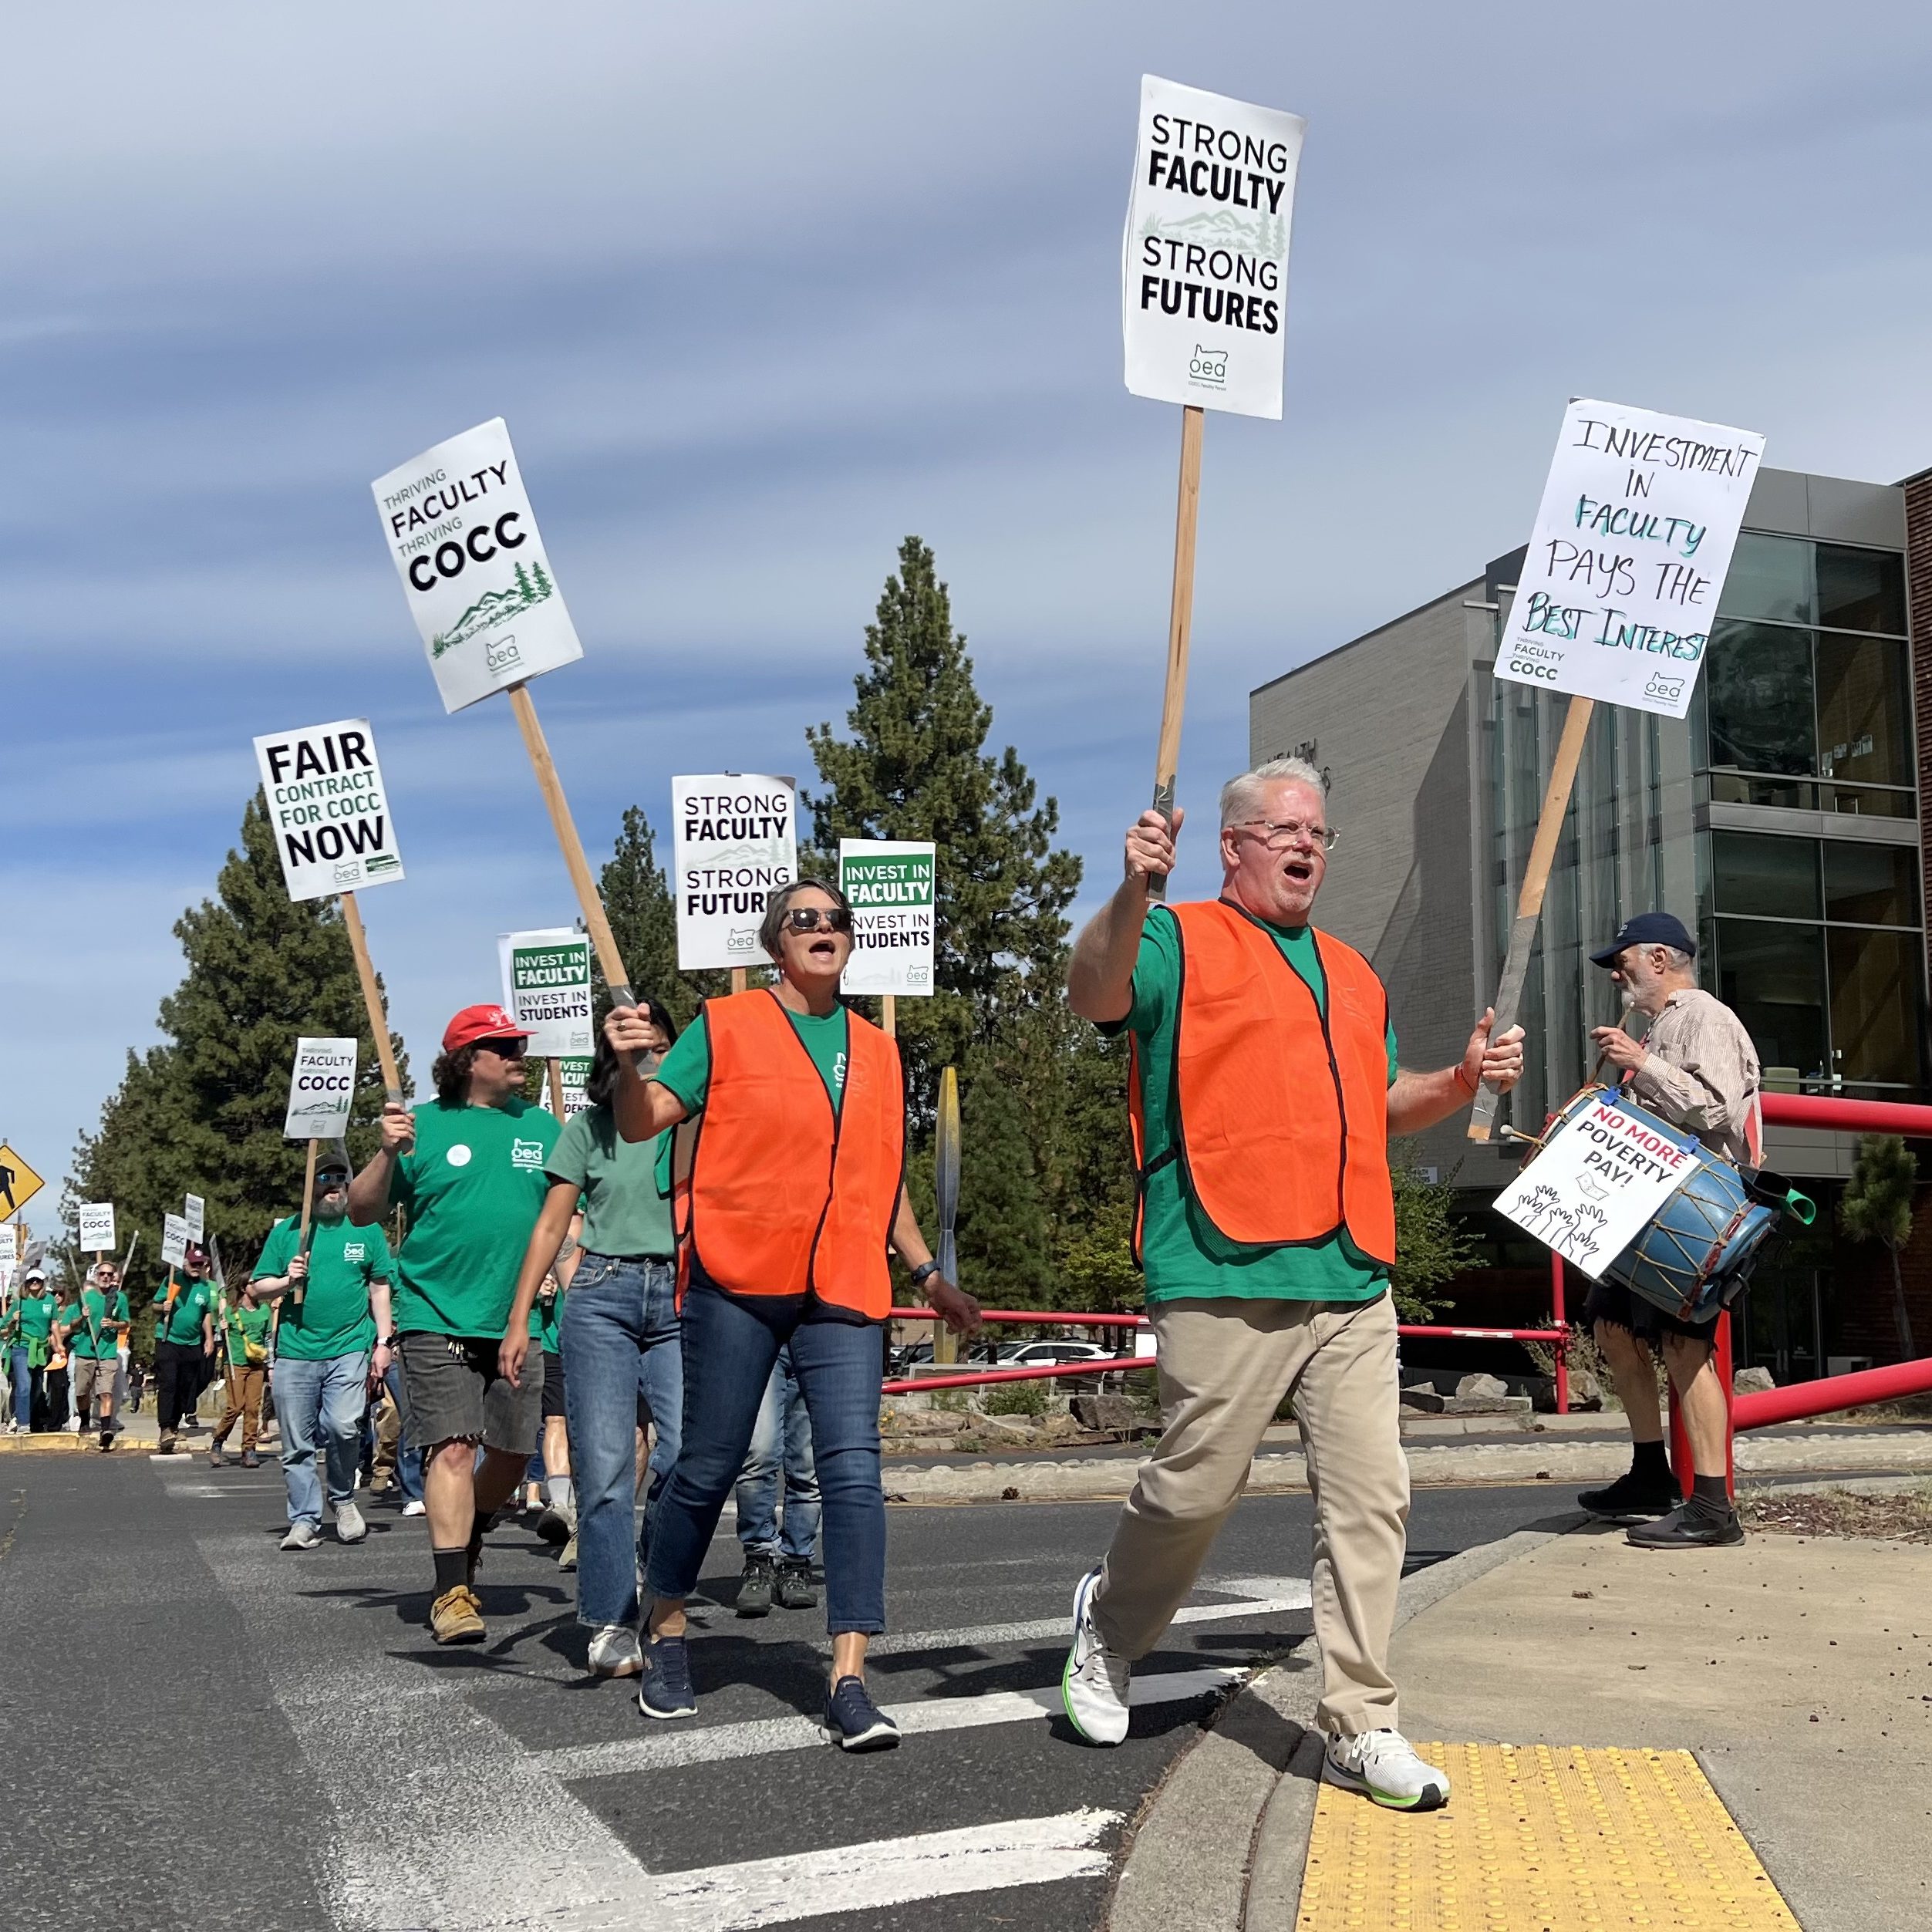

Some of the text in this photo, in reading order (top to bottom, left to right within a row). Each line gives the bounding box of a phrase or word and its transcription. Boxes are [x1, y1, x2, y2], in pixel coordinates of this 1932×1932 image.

[1151, 114, 1288, 174] STRONG
[1148, 150, 1286, 215] FACULTY
[1142, 235, 1279, 292] STRONG
[1141, 274, 1280, 335] FUTURES
[1189, 359, 1226, 378] oea
[1572, 420, 1758, 477] INVESTMENT
[383, 468, 447, 510] THRIVING
[1625, 467, 1655, 497] IN
[390, 460, 507, 538] FACULTY
[397, 516, 464, 558] THRIVING
[1576, 494, 1707, 558] FACULTY
[409, 511, 528, 592] COCC
[1546, 538, 1711, 605] PAYS THE
[1522, 592, 1709, 661] BEST INTEREST
[487, 646, 518, 666] oea
[1514, 643, 1565, 662] FACULTY
[1509, 660, 1559, 680] COCC
[1645, 682, 1681, 697] oea
[266, 731, 373, 784] FAIR
[275, 770, 375, 804] CONTRACT
[279, 792, 382, 828] FOR COCC
[685, 794, 787, 815] STRONG
[285, 814, 385, 868] NOW
[685, 816, 787, 841] FACULTY
[686, 867, 790, 889] STRONG
[846, 864, 930, 882] INVEST IN
[687, 892, 768, 915] FUTUR
[847, 881, 931, 904] FACULTY
[853, 914, 929, 929] NVEST IN
[727, 937, 754, 946] oea
[855, 931, 930, 949] TUDENTS
[515, 950, 585, 968] INVEST IN
[517, 965, 586, 986] FACULTY
[518, 990, 587, 1006] INVEST IN
[520, 1004, 588, 1021] STUDENTS
[300, 1056, 355, 1066] FACULTY
[559, 1060, 590, 1071] VEST
[298, 1076, 350, 1091] COCC
[1592, 1107, 1688, 1169] NO MORE
[1576, 1120, 1674, 1183] POVERTY
[1583, 1150, 1634, 1188] PAY!
